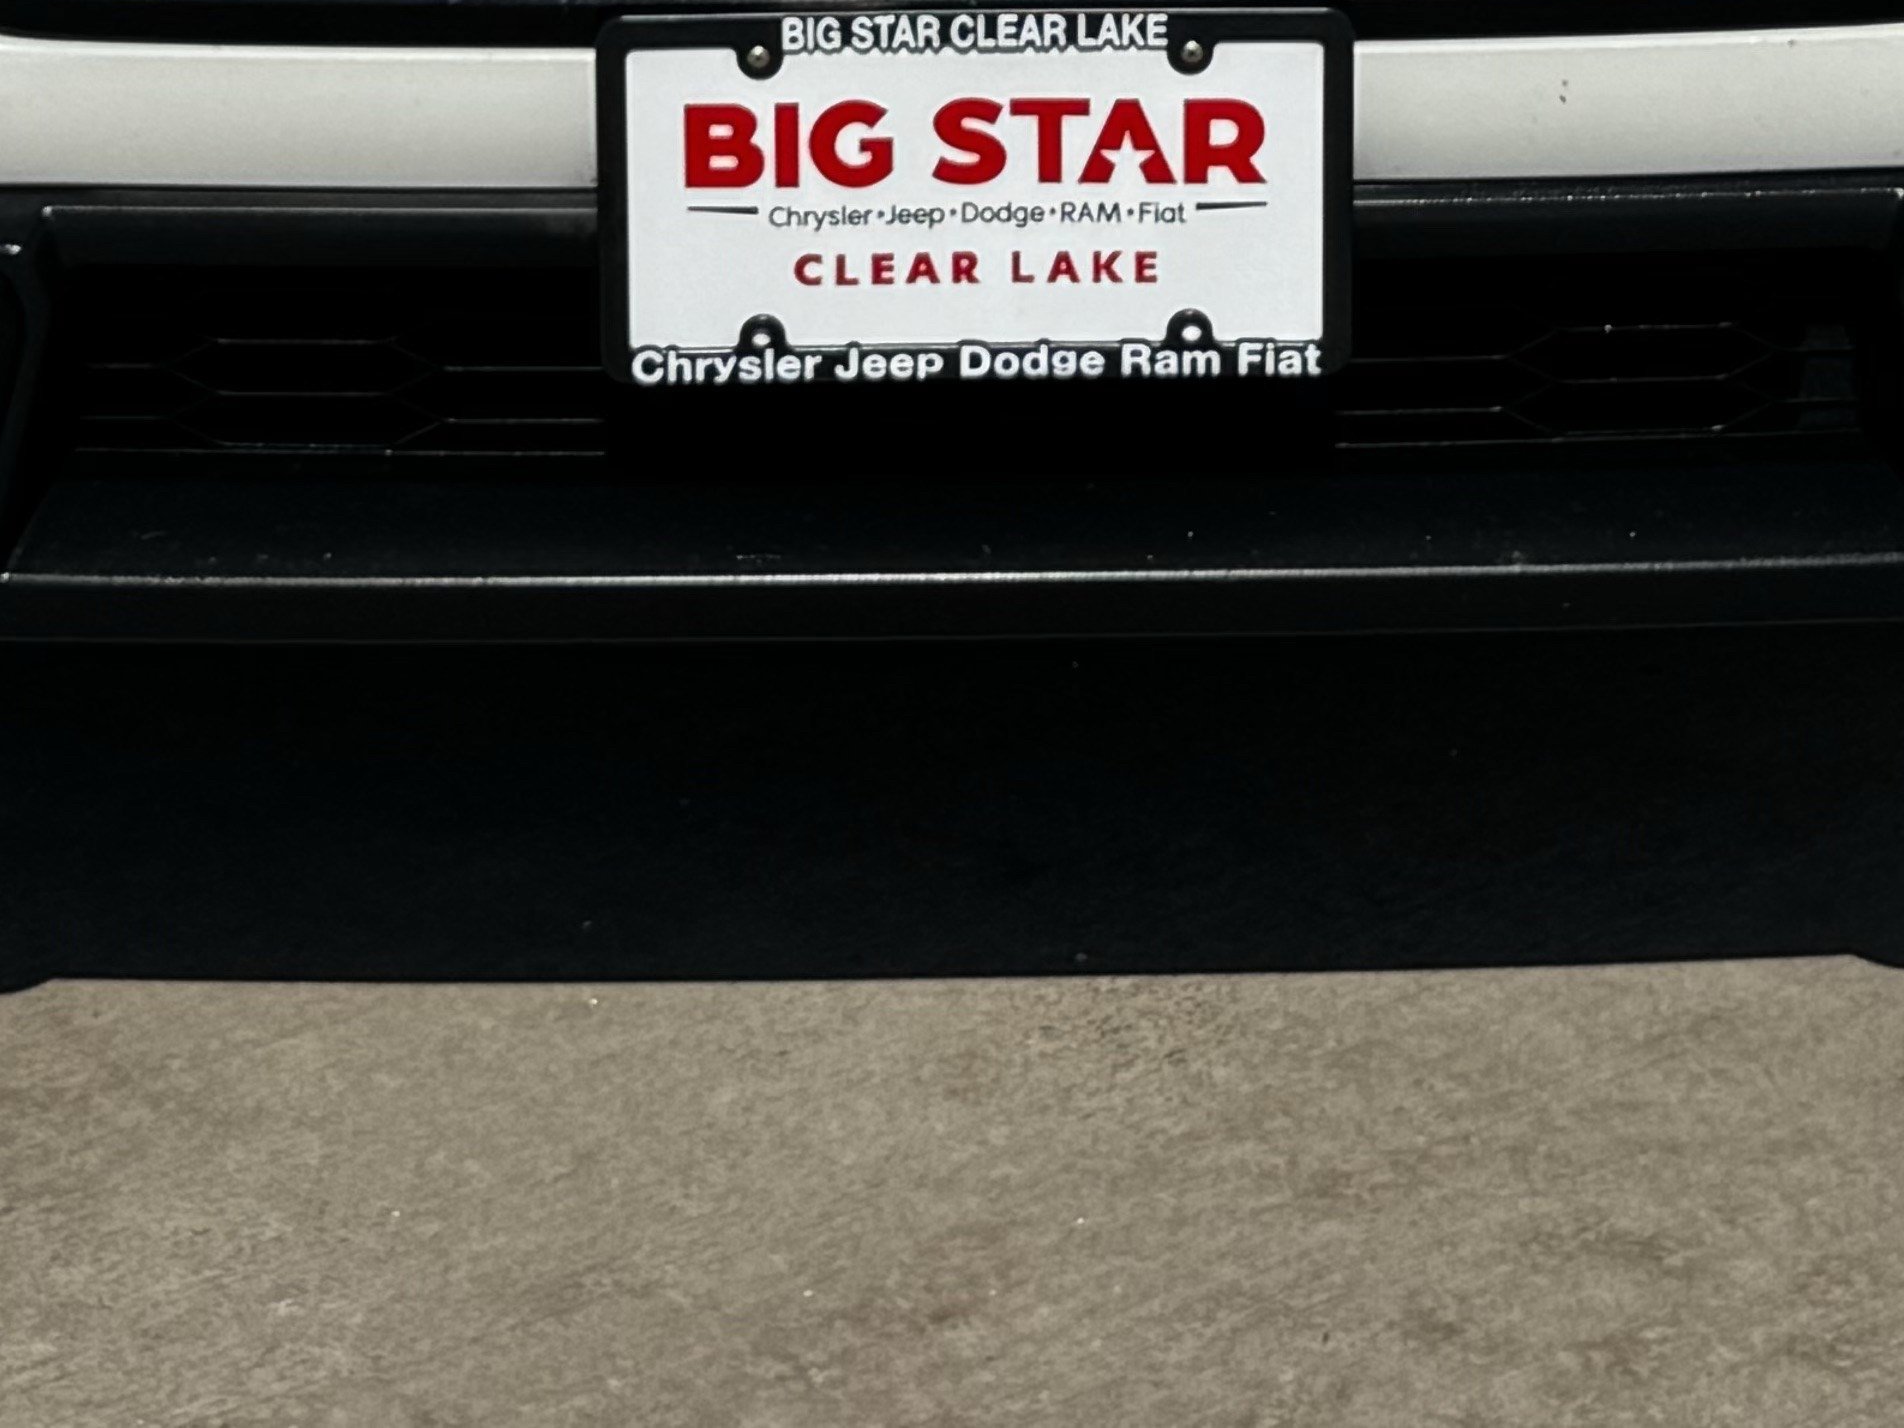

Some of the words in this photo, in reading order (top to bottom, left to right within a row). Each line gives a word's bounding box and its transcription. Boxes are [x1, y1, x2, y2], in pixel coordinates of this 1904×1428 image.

[782, 14, 841, 50] BIG
[851, 14, 941, 49] STAR
[950, 14, 1067, 48] CLEAR
[1077, 13, 1169, 47] LAKE
[684, 99, 894, 189] BIG
[932, 97, 1268, 186] STAR
[769, 205, 874, 233] Chrysler
[885, 204, 946, 230] Jeep
[961, 201, 1046, 229] Dodge
[1060, 201, 1122, 224] RAM
[1138, 201, 1187, 224] Fiat
[793, 252, 980, 286] CLEAR
[1011, 250, 1159, 284] LAKE
[632, 348, 822, 384] Chrysler
[834, 346, 944, 381] Jeep
[959, 344, 1106, 380] Dodge
[1120, 343, 1221, 378] Ram
[1238, 342, 1322, 377] Fiat
